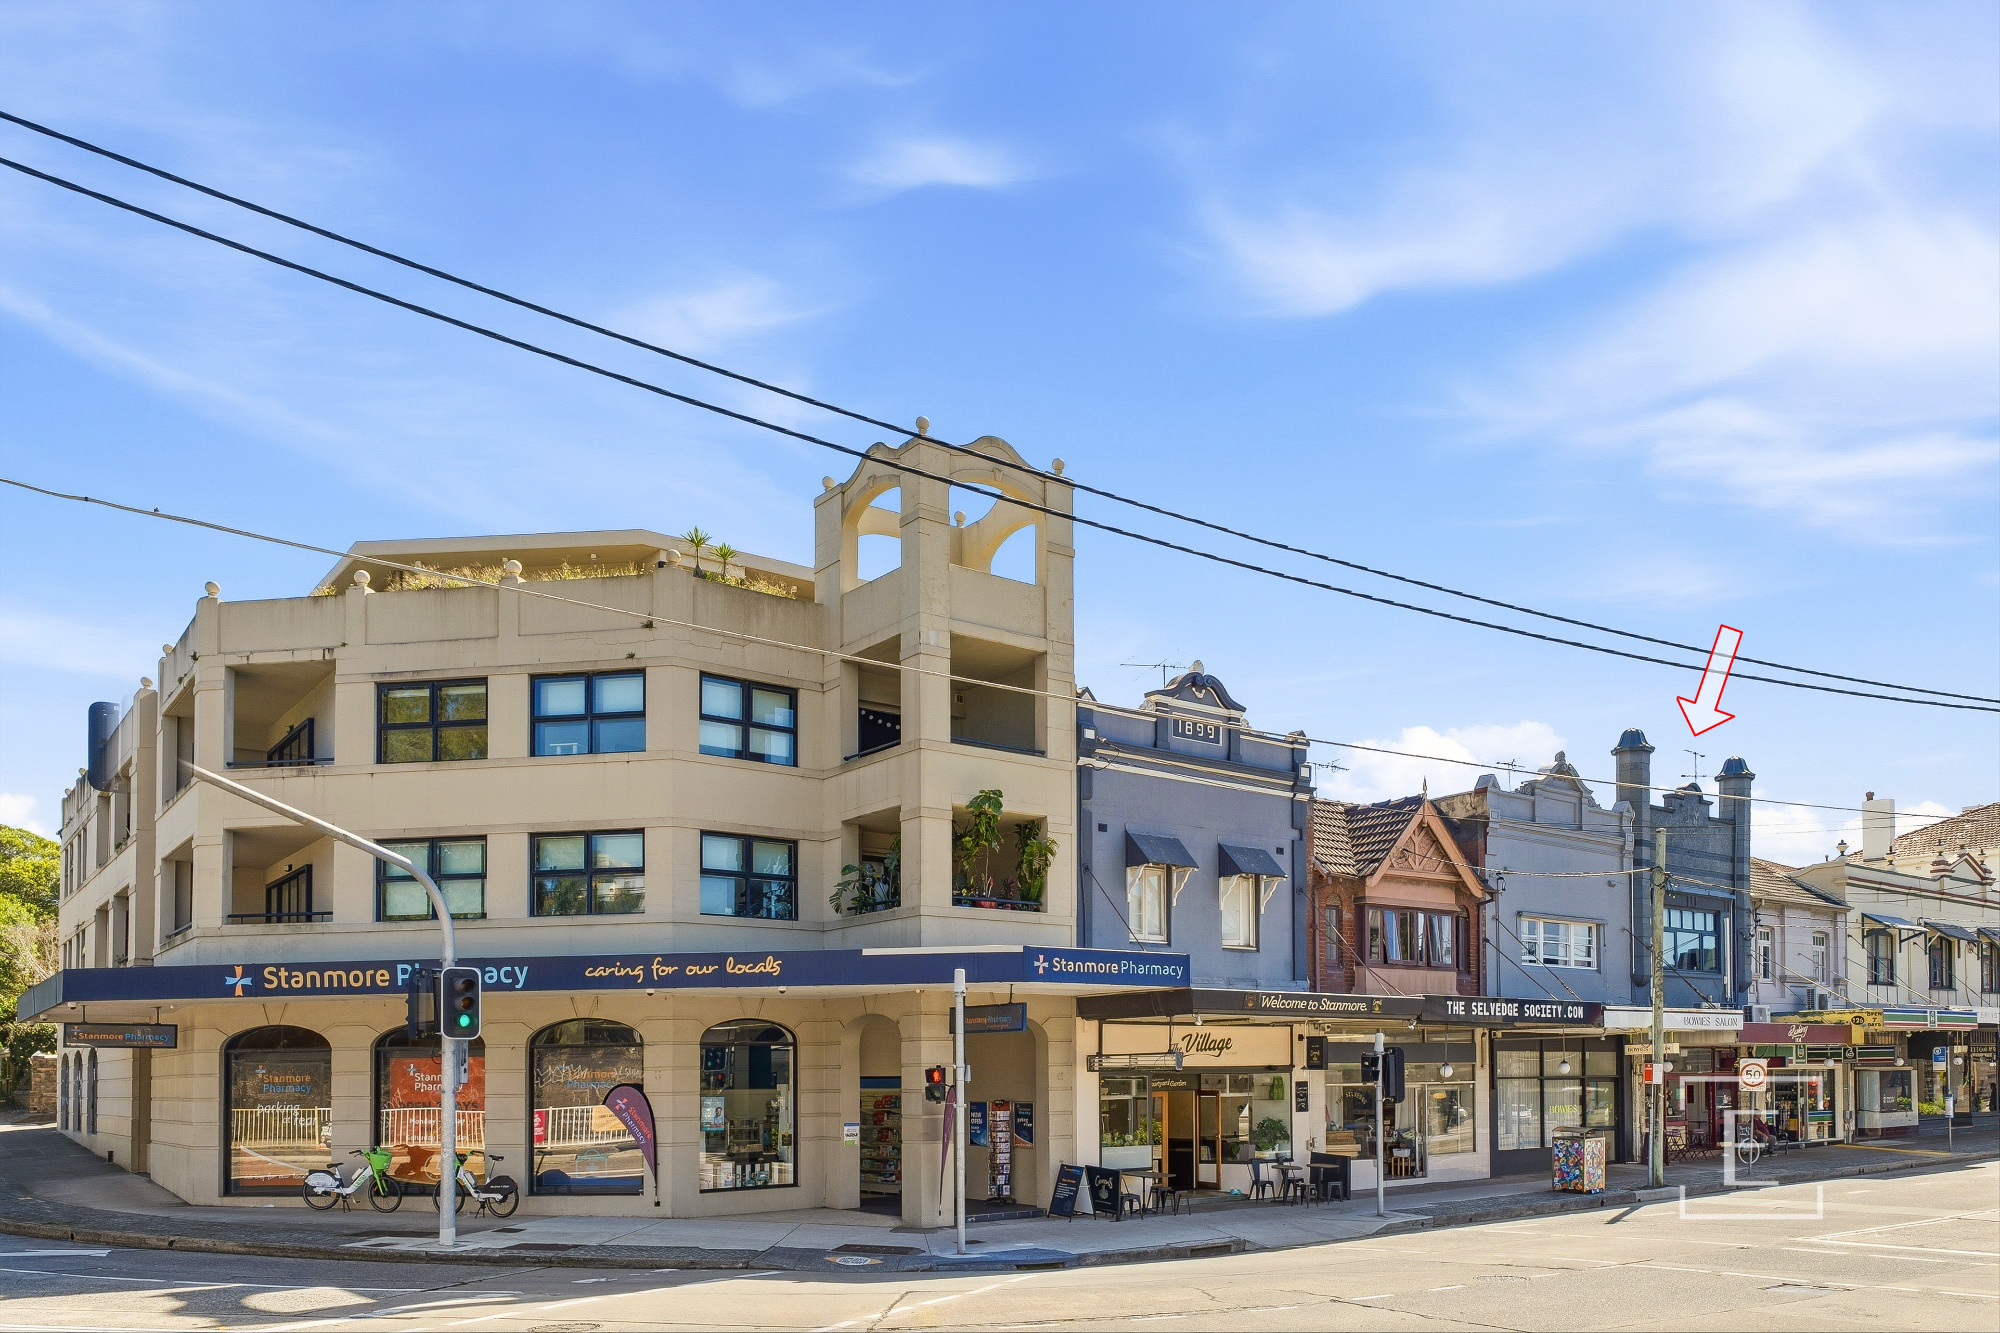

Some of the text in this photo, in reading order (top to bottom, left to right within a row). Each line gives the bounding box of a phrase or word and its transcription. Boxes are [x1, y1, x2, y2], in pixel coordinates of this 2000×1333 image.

[1179, 720, 1215, 739] 1899
[263, 963, 529, 989] Stanmore Pacy
[585, 955, 783, 983] caring for our locals
[1052, 957, 1184, 979] Stanmore Pharmacy
[1261, 995, 1306, 1009] Welcome
[1308, 1000, 1318, 1011] to
[1319, 998, 1368, 1011] Stanmore.
[1447, 1001, 1584, 1019] THE SELVEDGE SOCIETY.COM
[1715, 1017, 1738, 1027] SALON
[125, 1033, 170, 1042] Pharmacy
[1182, 1032, 1233, 1057] Village
[262, 1074, 311, 1083] Stanmore
[1746, 1070, 1761, 1079] 50
[263, 1084, 312, 1093] Pharmacy
[257, 1101, 301, 1117] parking
[622, 1111, 646, 1145] Pharmacy
[628, 1106, 652, 1139] Stanmore
